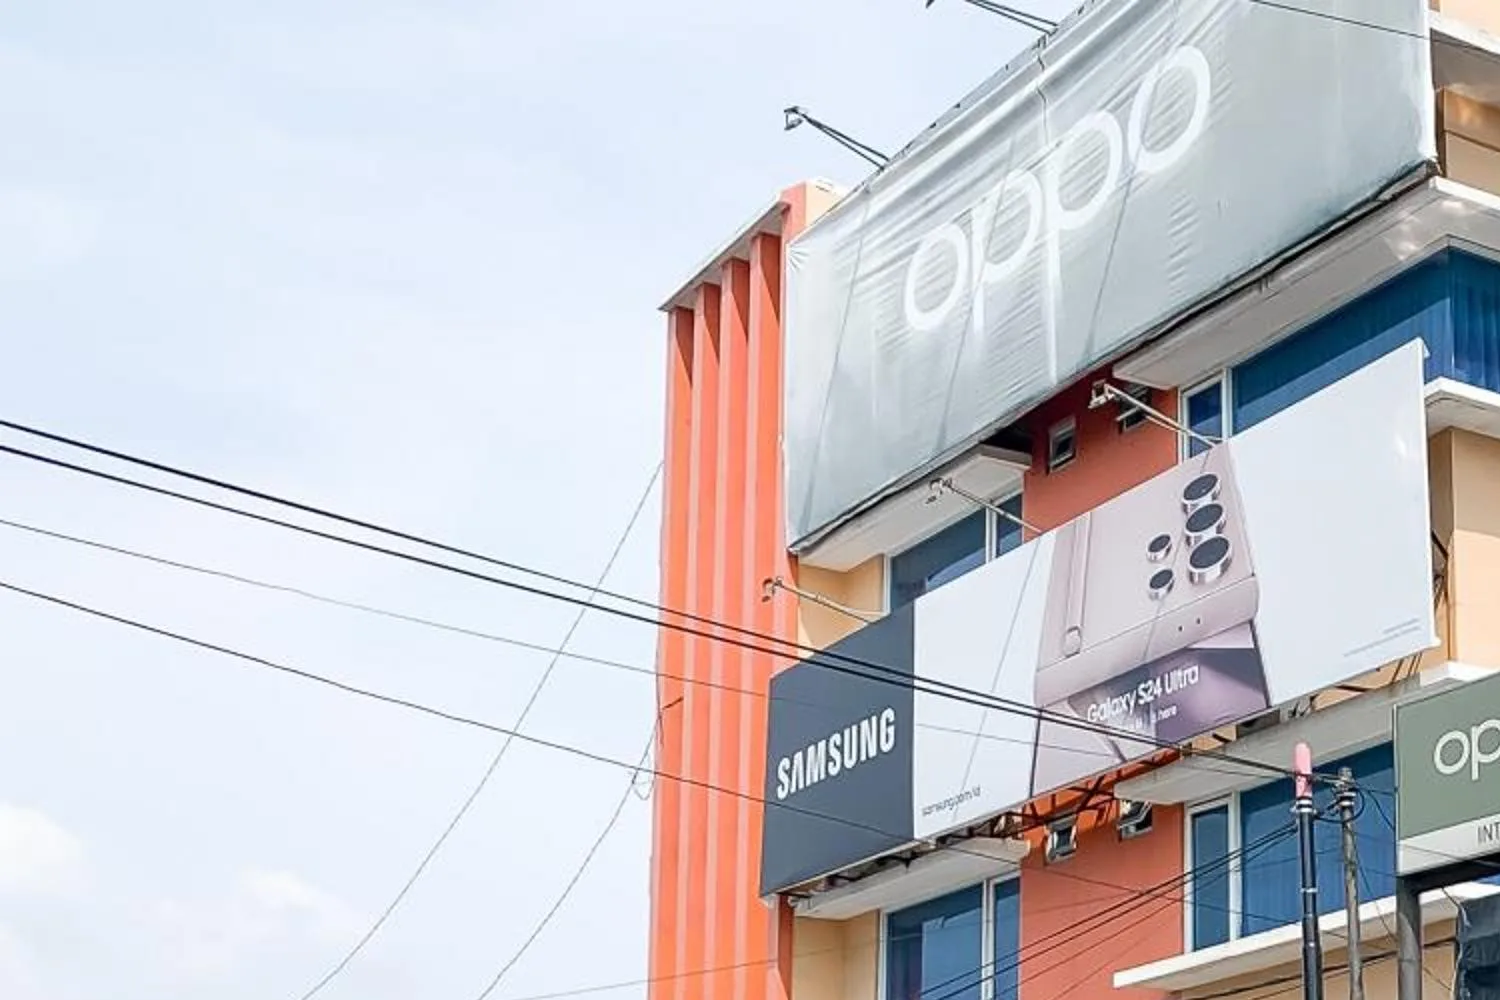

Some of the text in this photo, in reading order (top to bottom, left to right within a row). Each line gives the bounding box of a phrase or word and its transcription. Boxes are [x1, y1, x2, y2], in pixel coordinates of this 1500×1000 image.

[904, 45, 1212, 384] oppo
[1087, 692, 1136, 723] Galaxy
[1137, 681, 1163, 706] S24
[1164, 665, 1199, 694] Ultra
[776, 708, 895, 800] SAMSUNG
